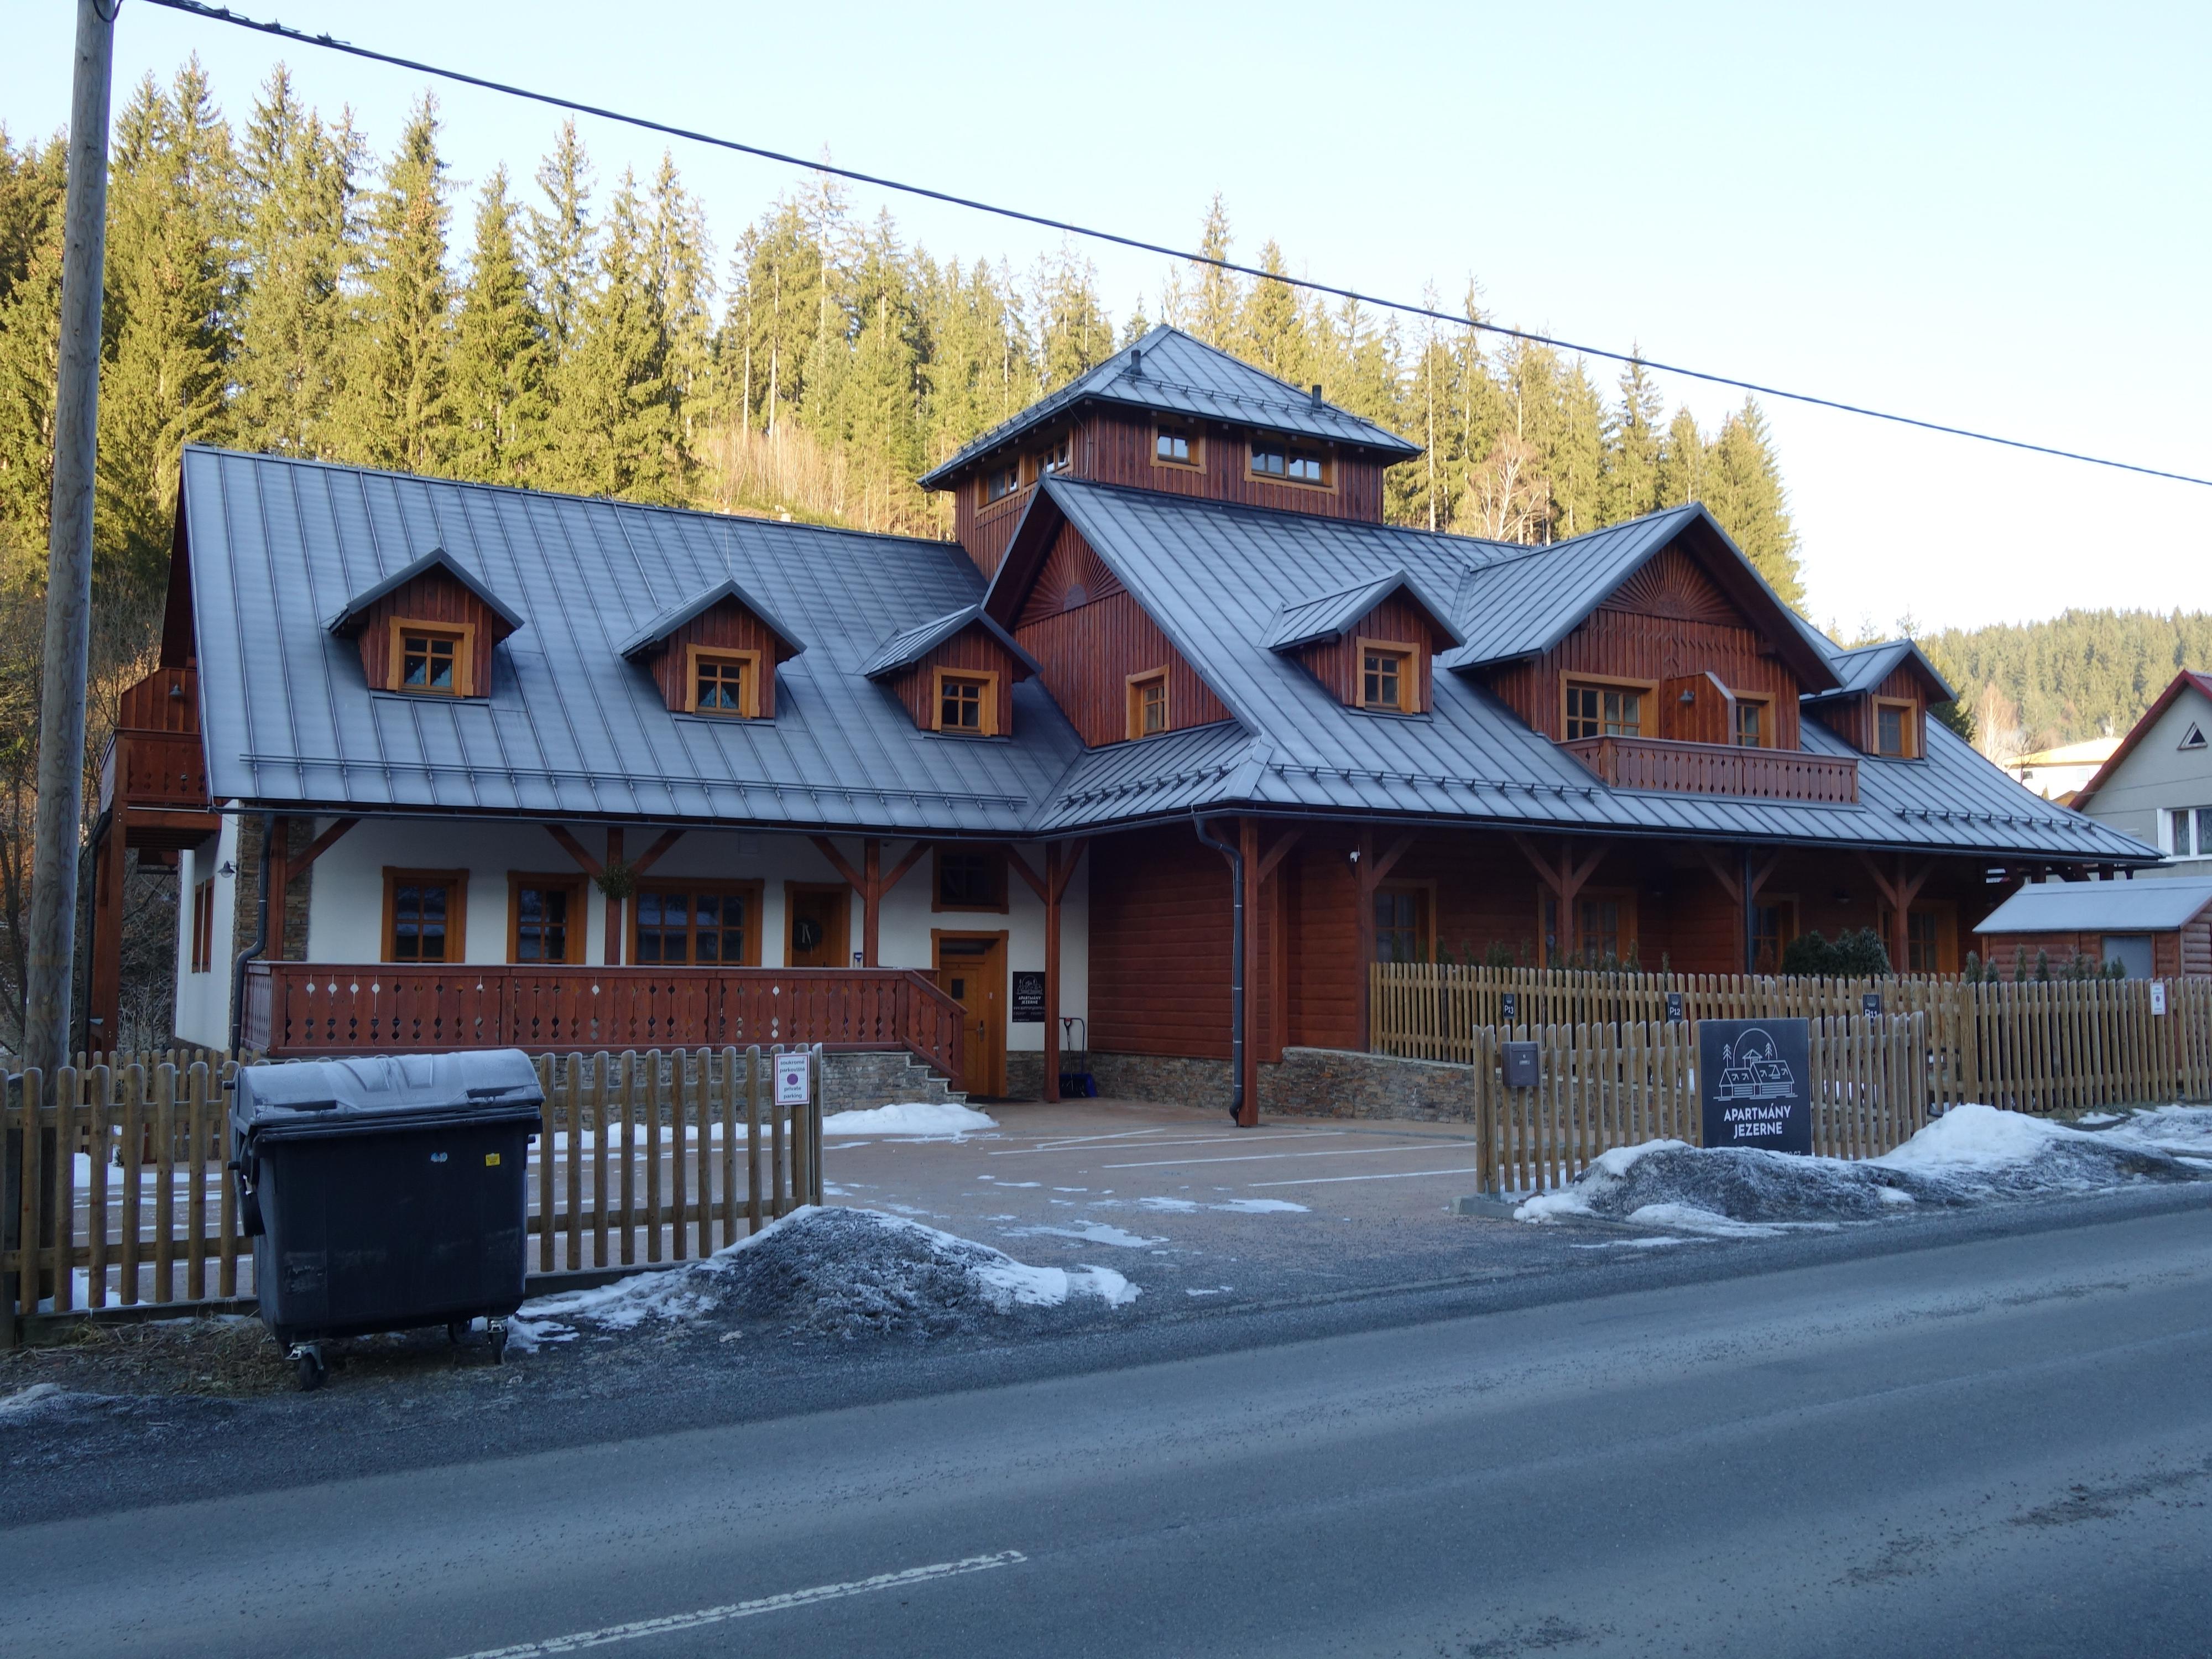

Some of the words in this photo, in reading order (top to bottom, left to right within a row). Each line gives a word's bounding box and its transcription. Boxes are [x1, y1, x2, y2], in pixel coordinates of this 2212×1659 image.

[1504, 1005, 1514, 1014] P13
[1670, 1006, 1681, 1016] P12
[1724, 1103, 1791, 1122] APARTMÁNY
[1733, 1121, 1783, 1140] JEZERNE
